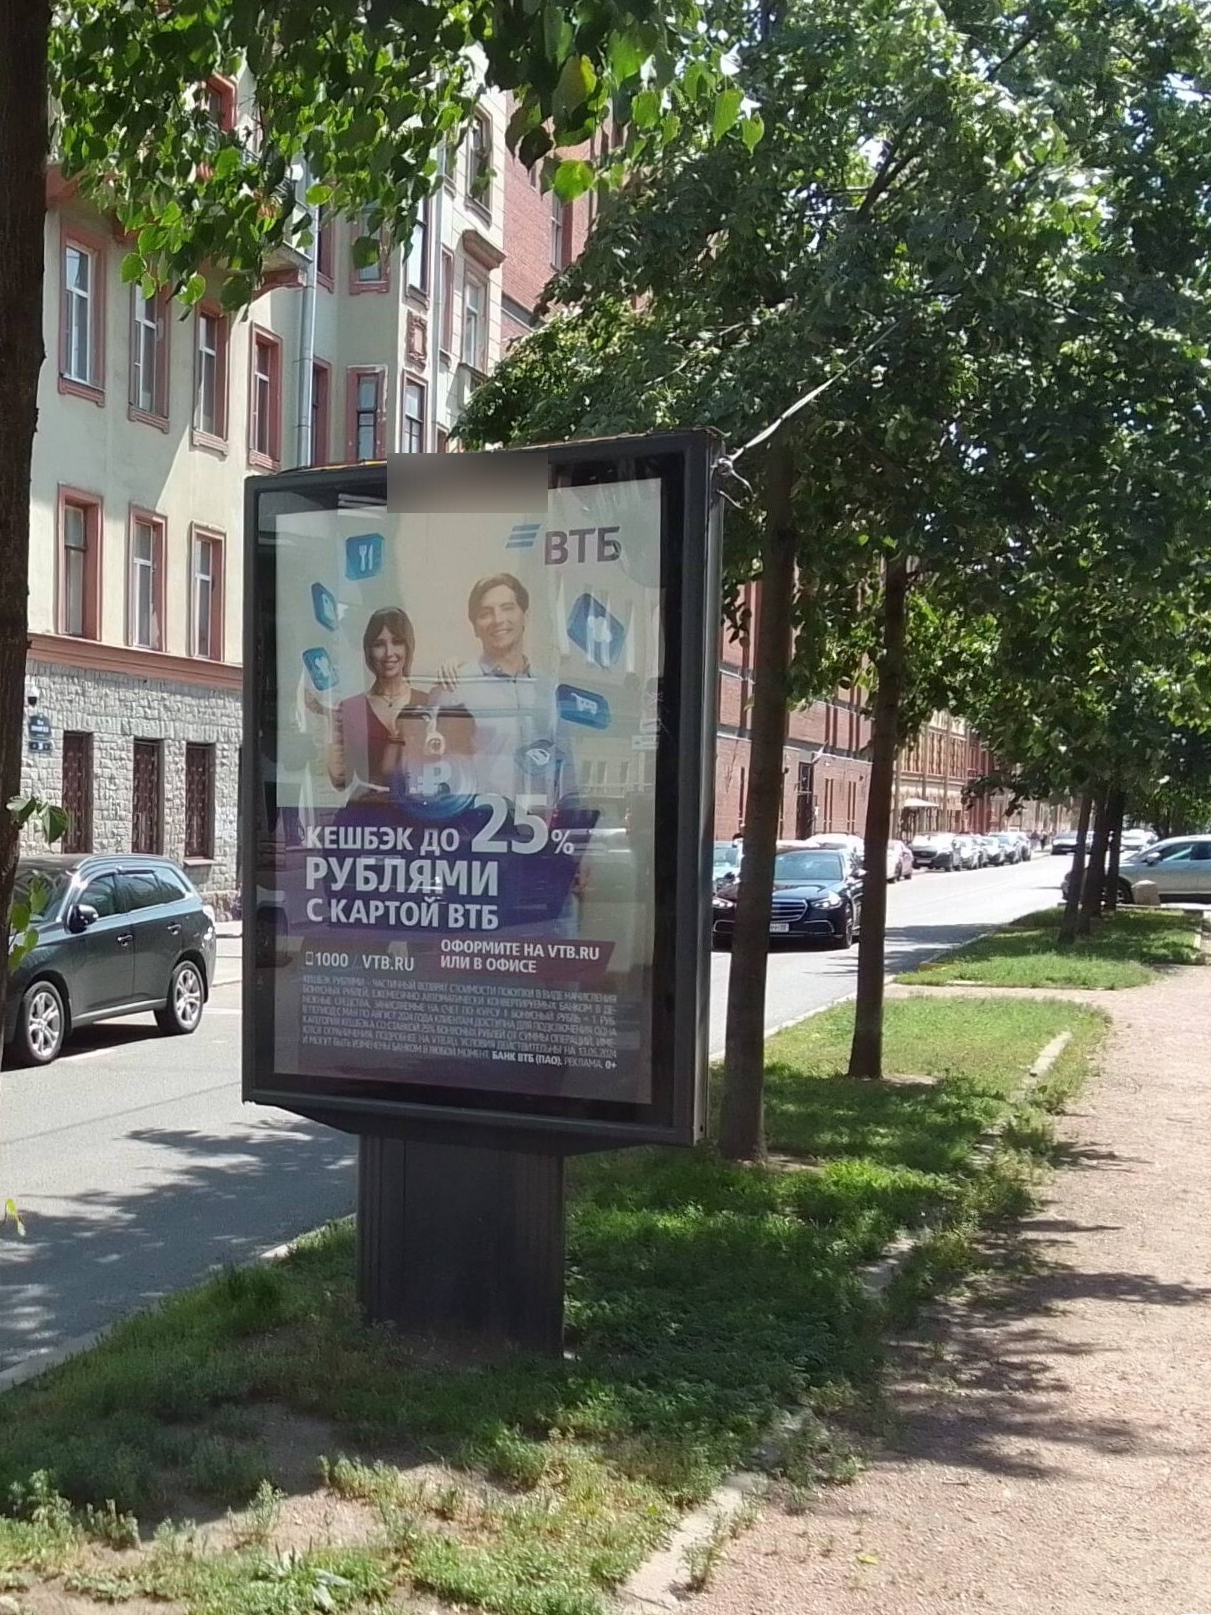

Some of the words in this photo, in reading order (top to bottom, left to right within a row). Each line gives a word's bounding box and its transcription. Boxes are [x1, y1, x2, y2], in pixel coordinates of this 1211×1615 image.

[544, 526, 621, 565] ВТБ
[306, 826, 413, 850] КЕШБЭК
[420, 828, 460, 856] ДО
[471, 793, 575, 855] 25%
[305, 857, 498, 896] РУБЛЯМИ
[306, 898, 323, 922] С
[330, 896, 439, 927] КАРТОЙ
[448, 904, 499, 930] ВТБ
[315, 952, 348, 967] 1000
[362, 954, 414, 971] VTB.RU
[441, 939, 520, 956] ОФОРМИТЕ
[524, 942, 544, 957] НА
[547, 944, 600, 960] VTB.RU
[441, 955, 469, 969] ИЛИ
[473, 957, 482, 970] В
[486, 958, 537, 973] ОФИСЕ
[492, 1049, 516, 1061] БАНК
[517, 1052, 534, 1063] ВТБ
